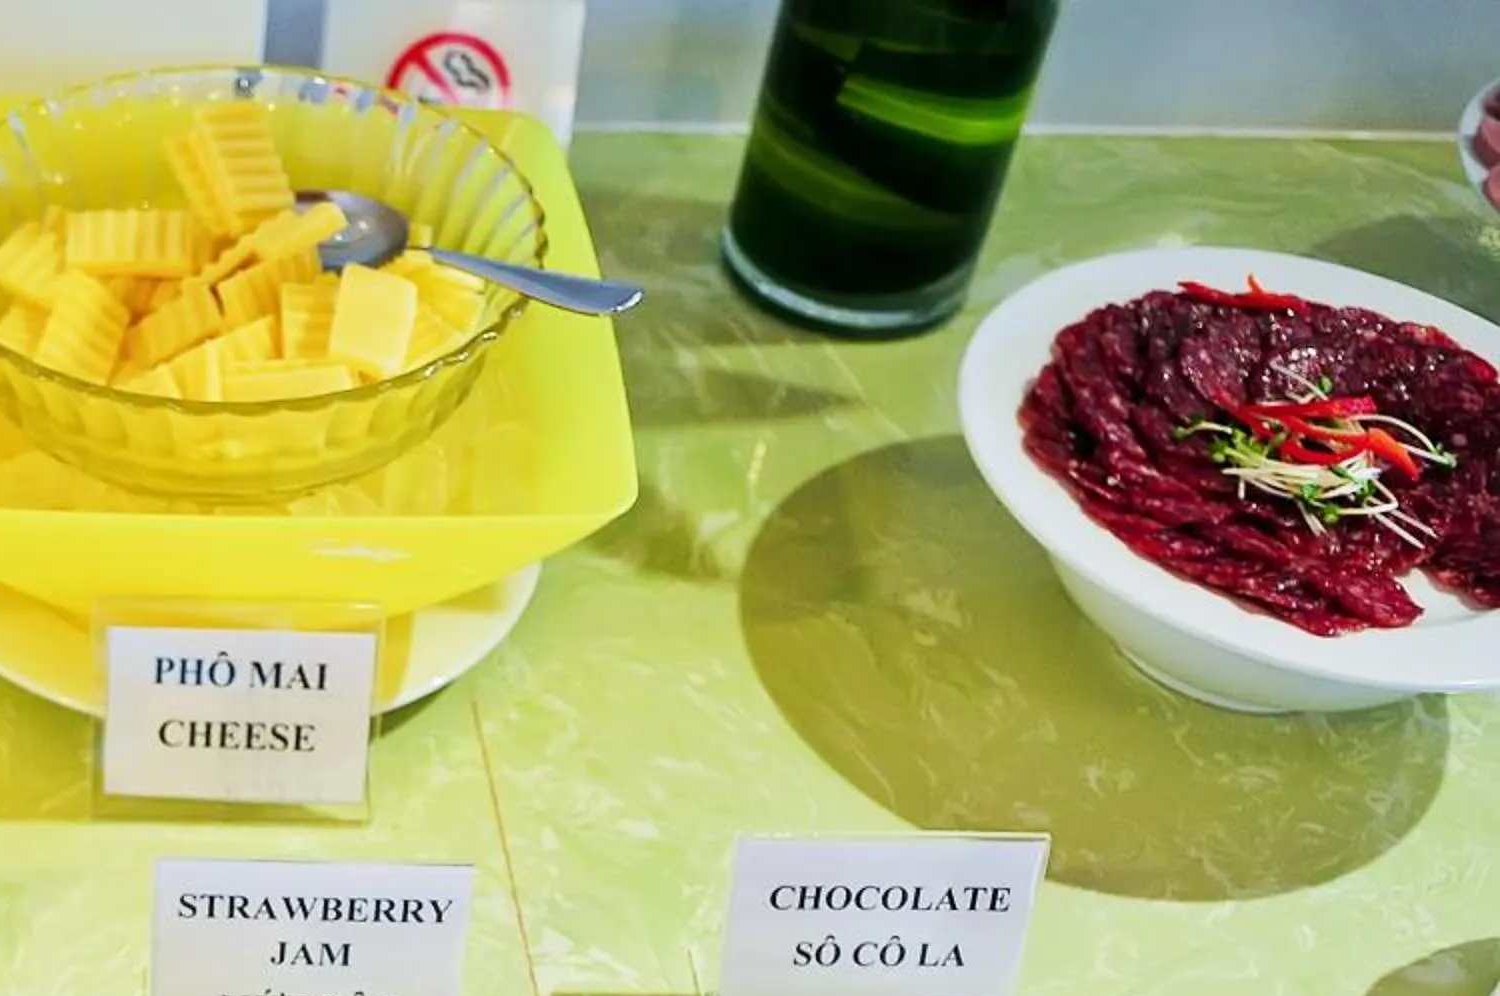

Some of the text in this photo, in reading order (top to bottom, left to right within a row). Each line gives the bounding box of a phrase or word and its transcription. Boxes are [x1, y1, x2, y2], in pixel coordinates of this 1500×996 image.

[153, 650, 328, 691] PHÔ MAI
[157, 719, 316, 752] CHEESE
[177, 892, 453, 924] STRAWBERRY
[768, 884, 1012, 913] CHOCOLATE
[269, 941, 353, 967] JAM
[792, 934, 965, 968] SÔ CÔ LA
